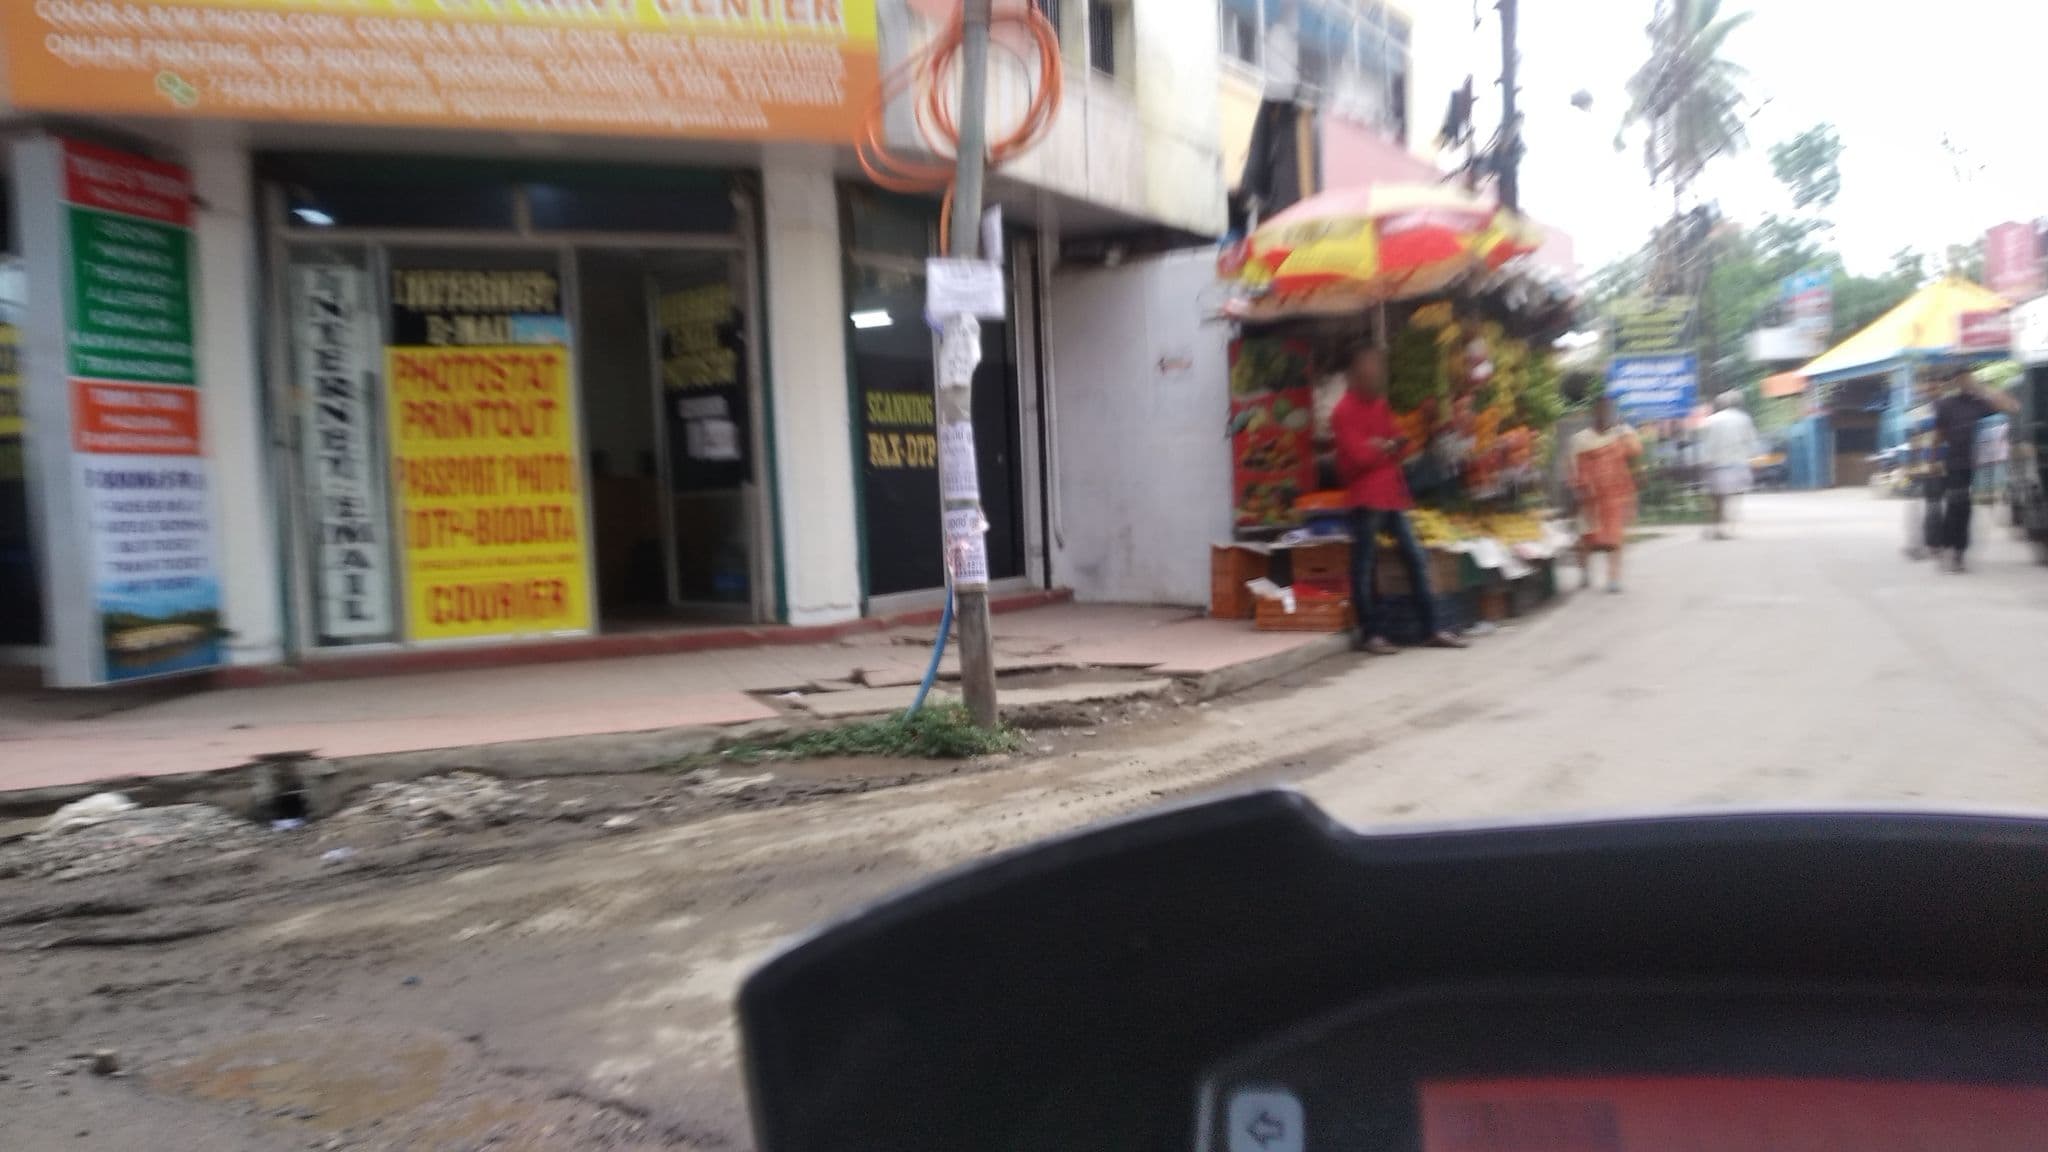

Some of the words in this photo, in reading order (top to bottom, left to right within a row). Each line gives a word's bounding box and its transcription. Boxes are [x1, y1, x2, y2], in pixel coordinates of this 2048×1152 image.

[394, 352, 556, 393] PHOTOSTAT
[402, 400, 557, 439] PRINTOUT
[428, 576, 568, 626] COURIER
